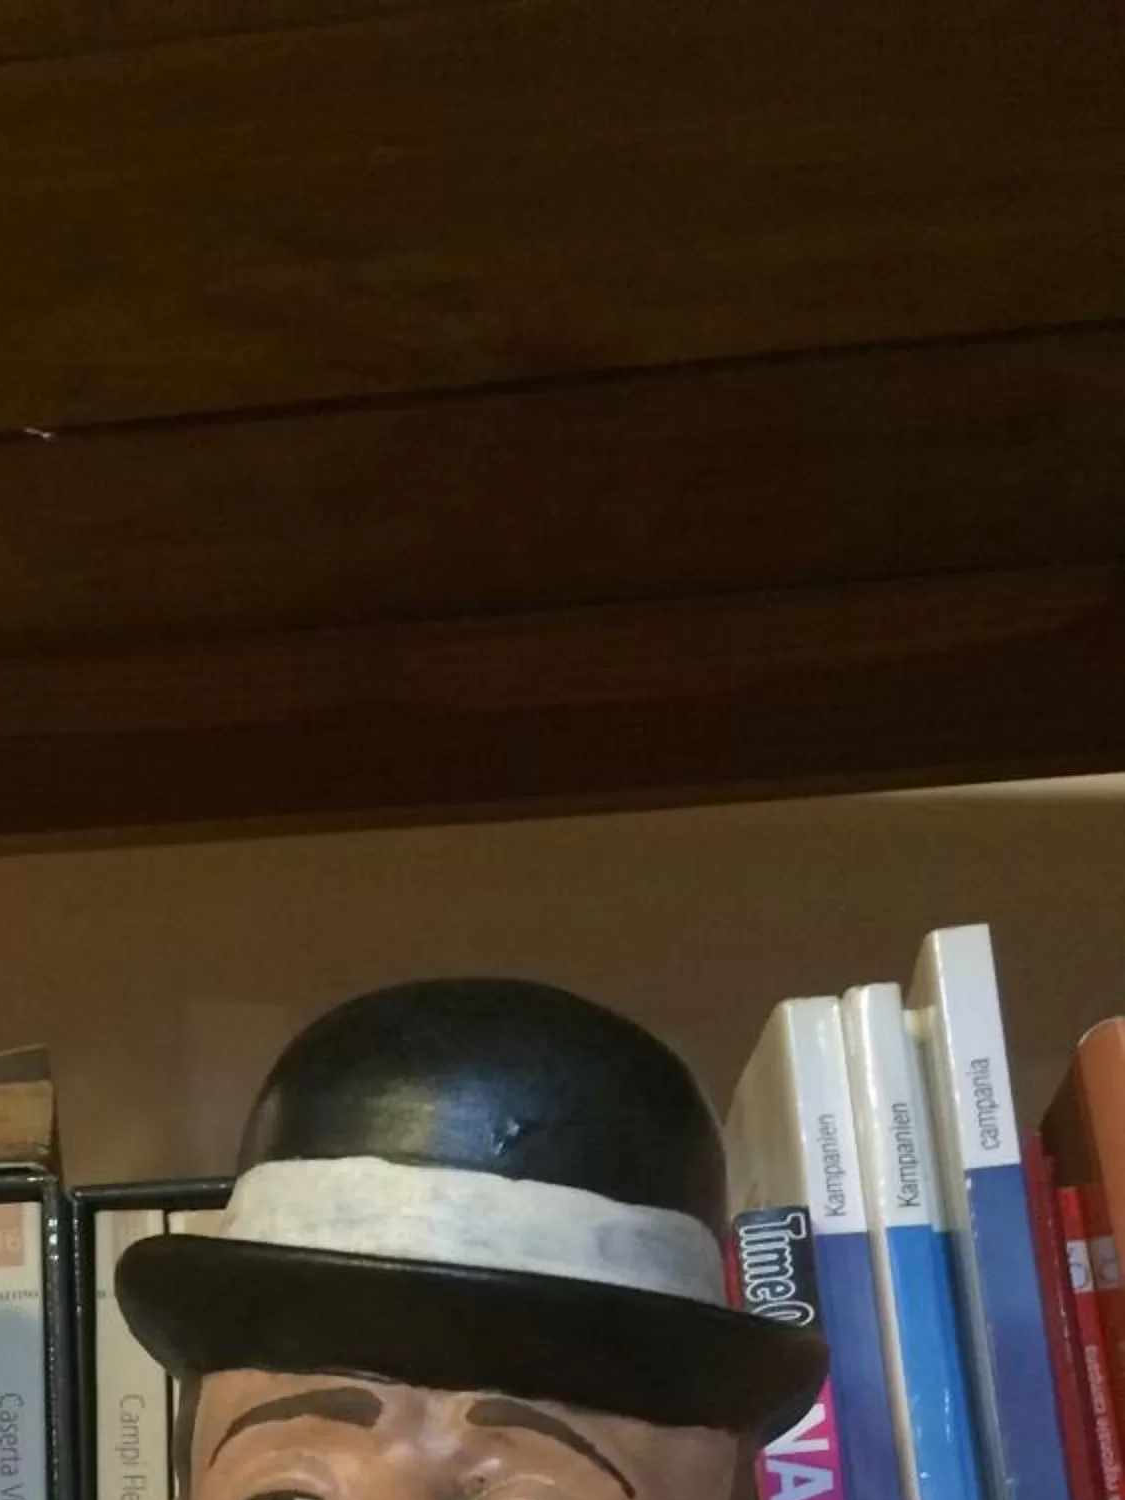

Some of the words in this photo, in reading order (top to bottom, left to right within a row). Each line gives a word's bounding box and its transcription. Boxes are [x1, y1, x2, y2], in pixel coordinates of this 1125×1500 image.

[816, 1113, 847, 1217] Kampanien
[889, 1102, 921, 1208] Kampanien
[739, 1212, 814, 1326] TimeO
[0, 1393, 25, 1476] Caserta
[115, 1394, 145, 1466] Campi
